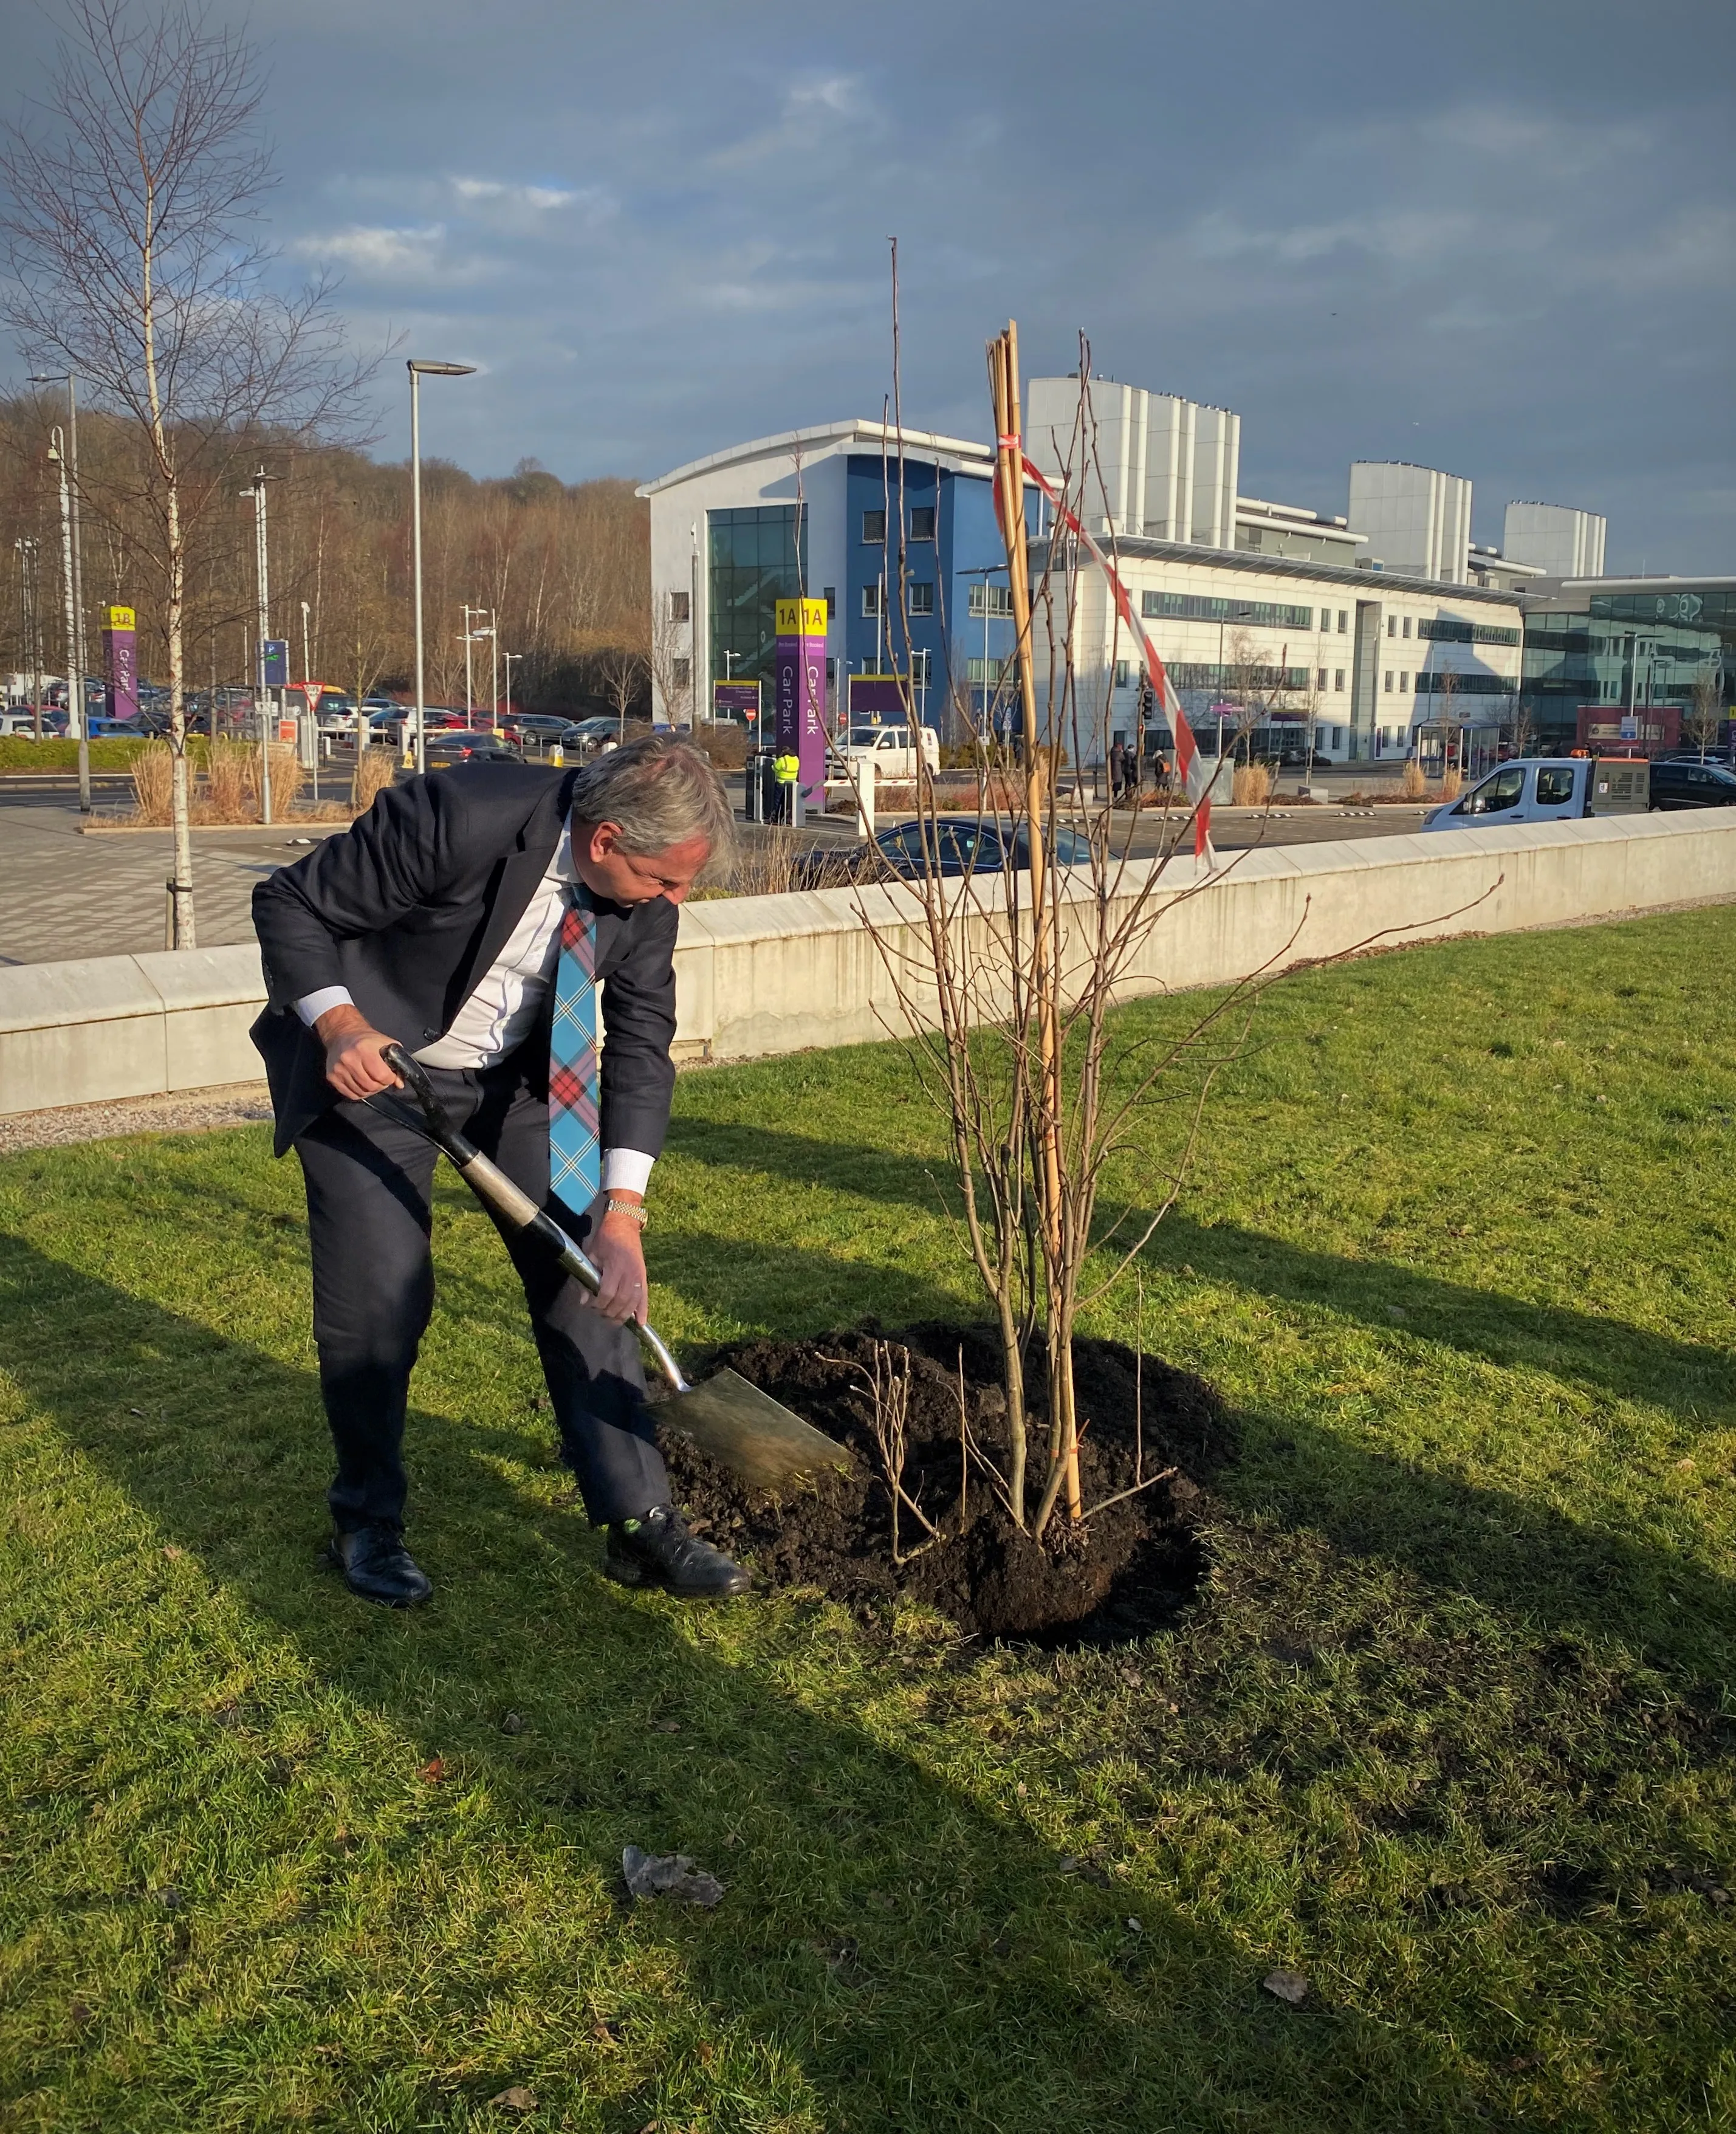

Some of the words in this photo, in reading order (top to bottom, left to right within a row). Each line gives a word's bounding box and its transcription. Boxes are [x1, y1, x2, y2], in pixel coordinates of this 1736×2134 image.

[115, 613, 130, 623] 1B
[780, 608, 797, 625] 1A
[803, 609, 823, 625] 1A
[783, 666, 793, 695] Car
[783, 699, 793, 734] Park
